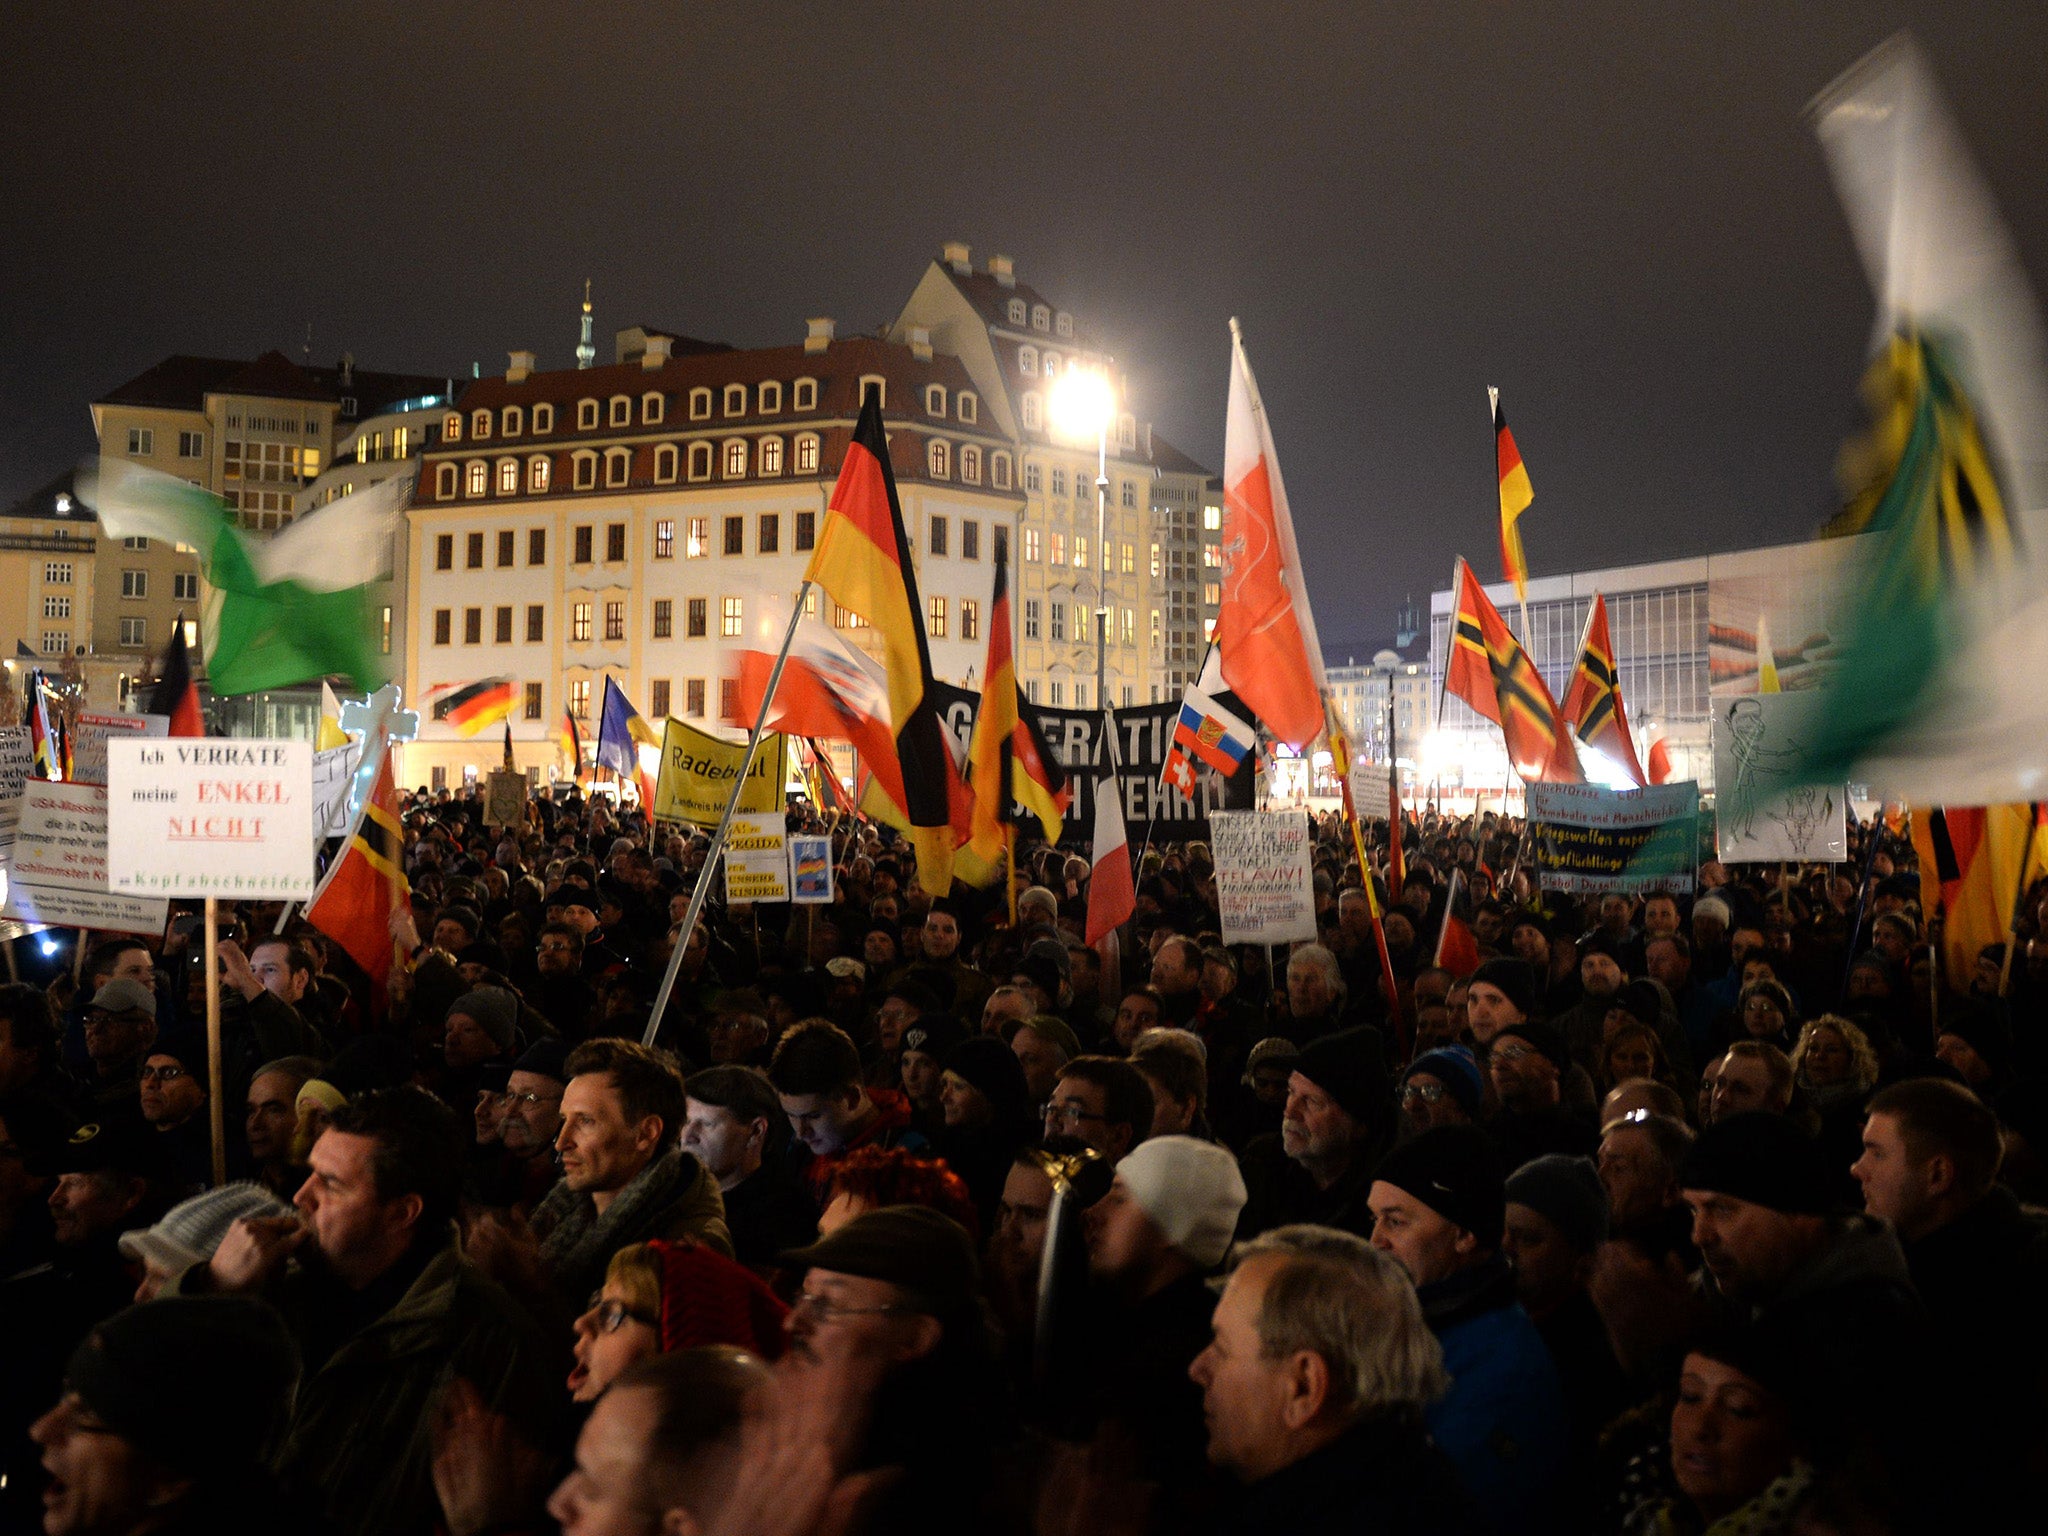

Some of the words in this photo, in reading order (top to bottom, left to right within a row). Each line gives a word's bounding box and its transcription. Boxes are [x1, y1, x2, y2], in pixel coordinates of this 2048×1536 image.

[140, 748, 164, 765] Ich
[177, 747, 288, 767] VERRATE
[132, 785, 178, 802] meine
[197, 780, 292, 805] ENKEL
[168, 815, 265, 840] NICHT
